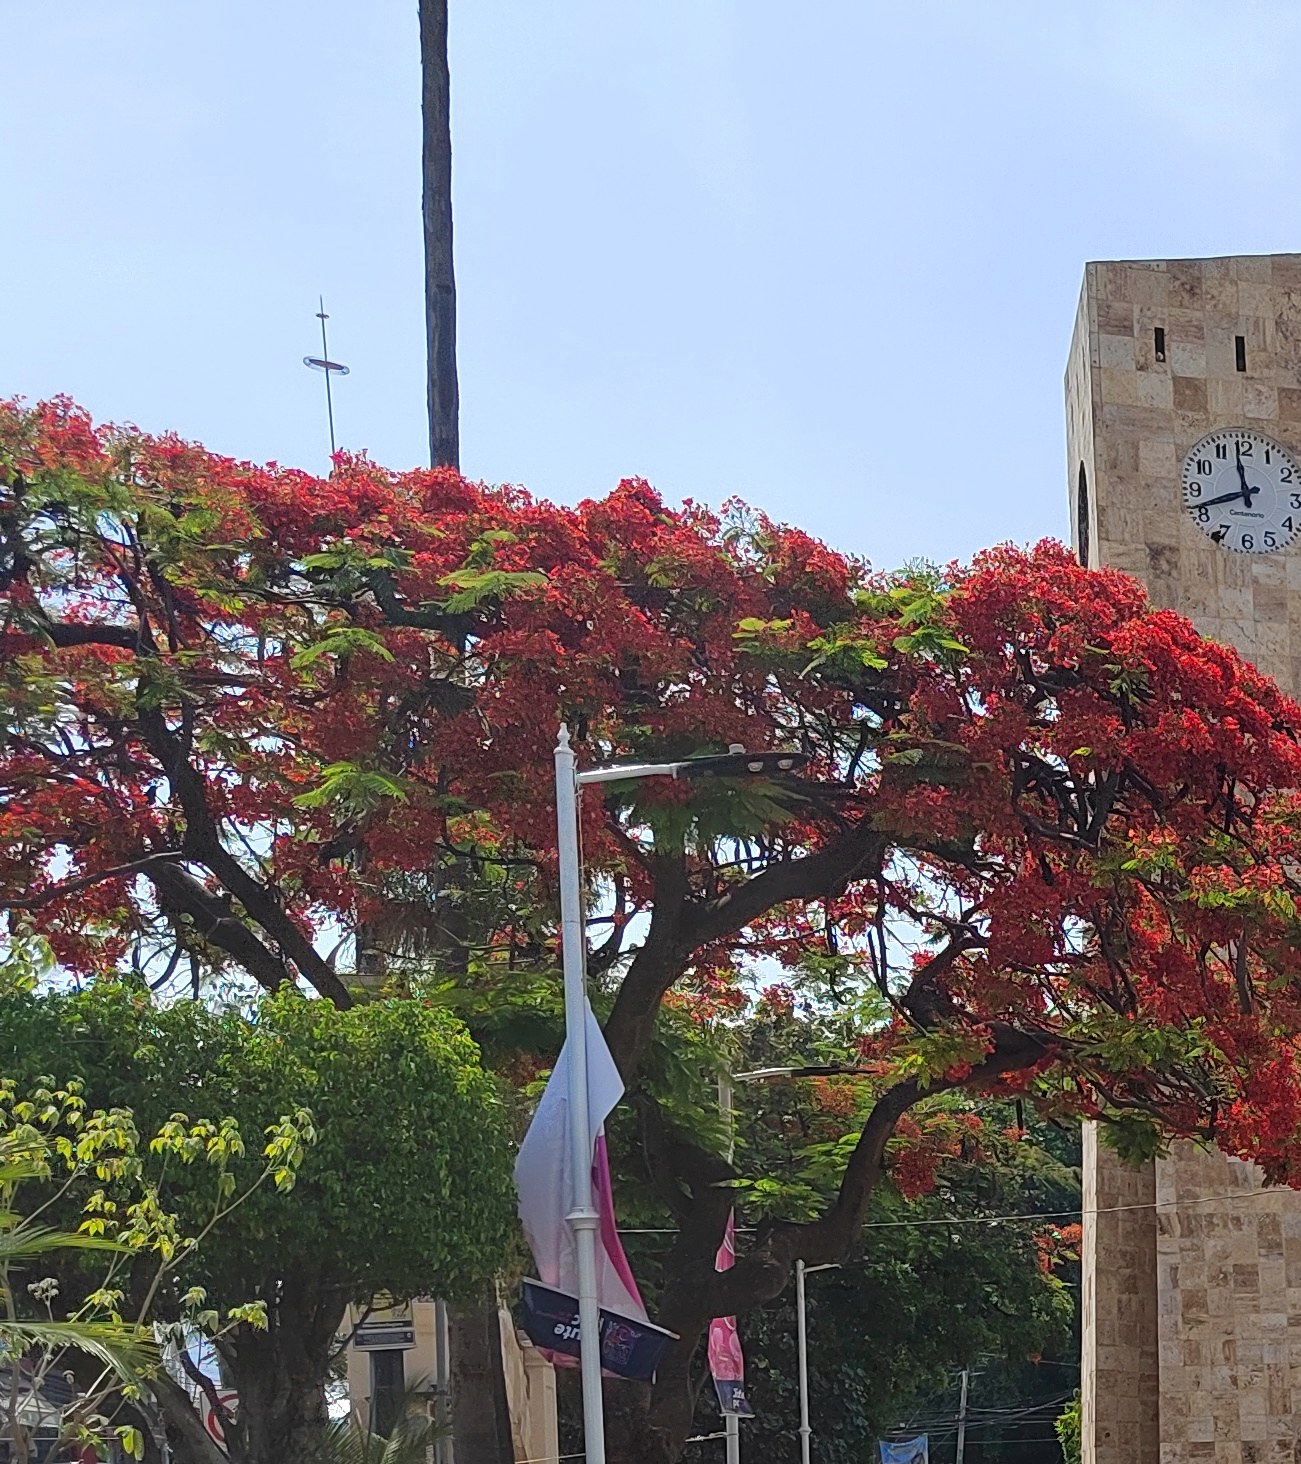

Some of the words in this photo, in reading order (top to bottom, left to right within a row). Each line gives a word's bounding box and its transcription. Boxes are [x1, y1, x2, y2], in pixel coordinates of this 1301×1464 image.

[1215, 443, 1227, 460] 11
[1234, 440, 1253, 457] 12
[1264, 448, 1271, 465] 1
[1196, 459, 1212, 475] 10
[1280, 467, 1293, 484] 2
[1189, 482, 1202, 498] 9
[1290, 493, 1301, 509] 3
[1198, 506, 1210, 522] 8
[1219, 524, 1231, 540] 7
[1281, 516, 1293, 532] 4
[1241, 534, 1254, 550] 6
[1264, 531, 1276, 547] 5
